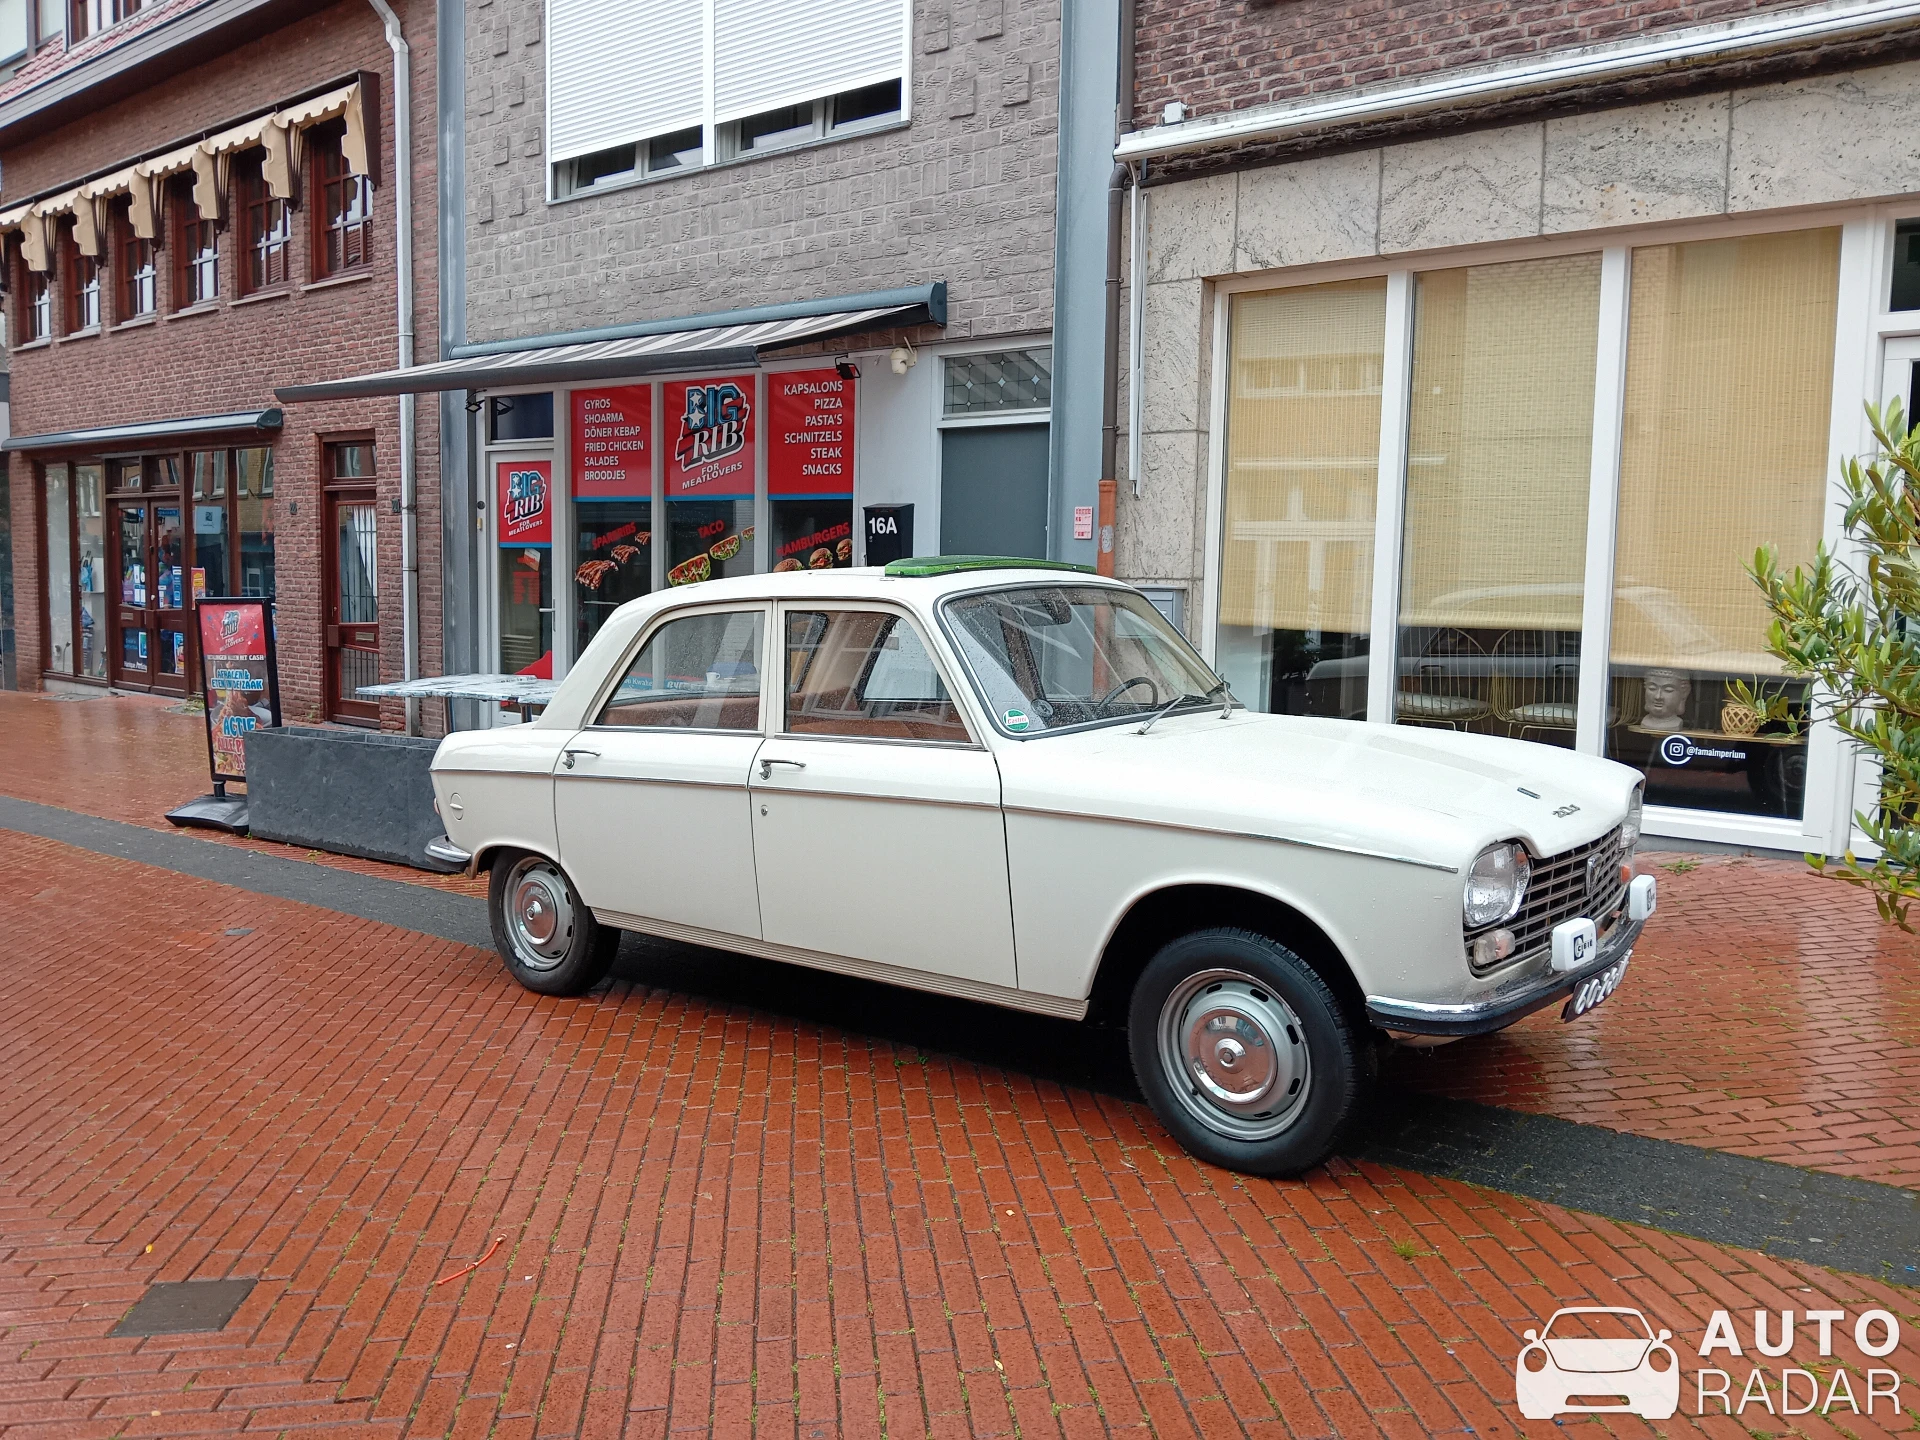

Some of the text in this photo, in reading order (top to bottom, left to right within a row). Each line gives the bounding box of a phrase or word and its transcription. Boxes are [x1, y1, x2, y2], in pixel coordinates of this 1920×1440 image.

[783, 380, 843, 396] KAPSALONS
[584, 398, 611, 410] GYROS
[687, 385, 739, 430] BIG
[814, 397, 843, 410] PIZZA
[584, 412, 625, 424] SHOARMA
[804, 414, 843, 427] PASTA'S
[584, 425, 641, 438] DÖNER KEBAP
[784, 431, 843, 444] SCHNITZELS
[584, 440, 644, 453] FRIED CHICKEN
[691, 420, 739, 460] RIB
[810, 446, 843, 459] STEAK
[584, 455, 619, 467] SALADES
[584, 469, 626, 481] BROODJES
[682, 461, 744, 490] MEATLOVERS
[701, 463, 720, 476] FOR
[802, 463, 842, 476] SNACKS
[511, 472, 540, 499] BIG
[514, 493, 541, 518] RIB
[508, 519, 544, 537] MEATLOVERS
[519, 519, 531, 528] FOR
[697, 519, 725, 539] TACO
[868, 516, 898, 535] 16A
[776, 522, 851, 557] HAMBURGERS
[241, 679, 264, 690] ZAAK
[1686, 746, 1746, 760] @famaimperium
